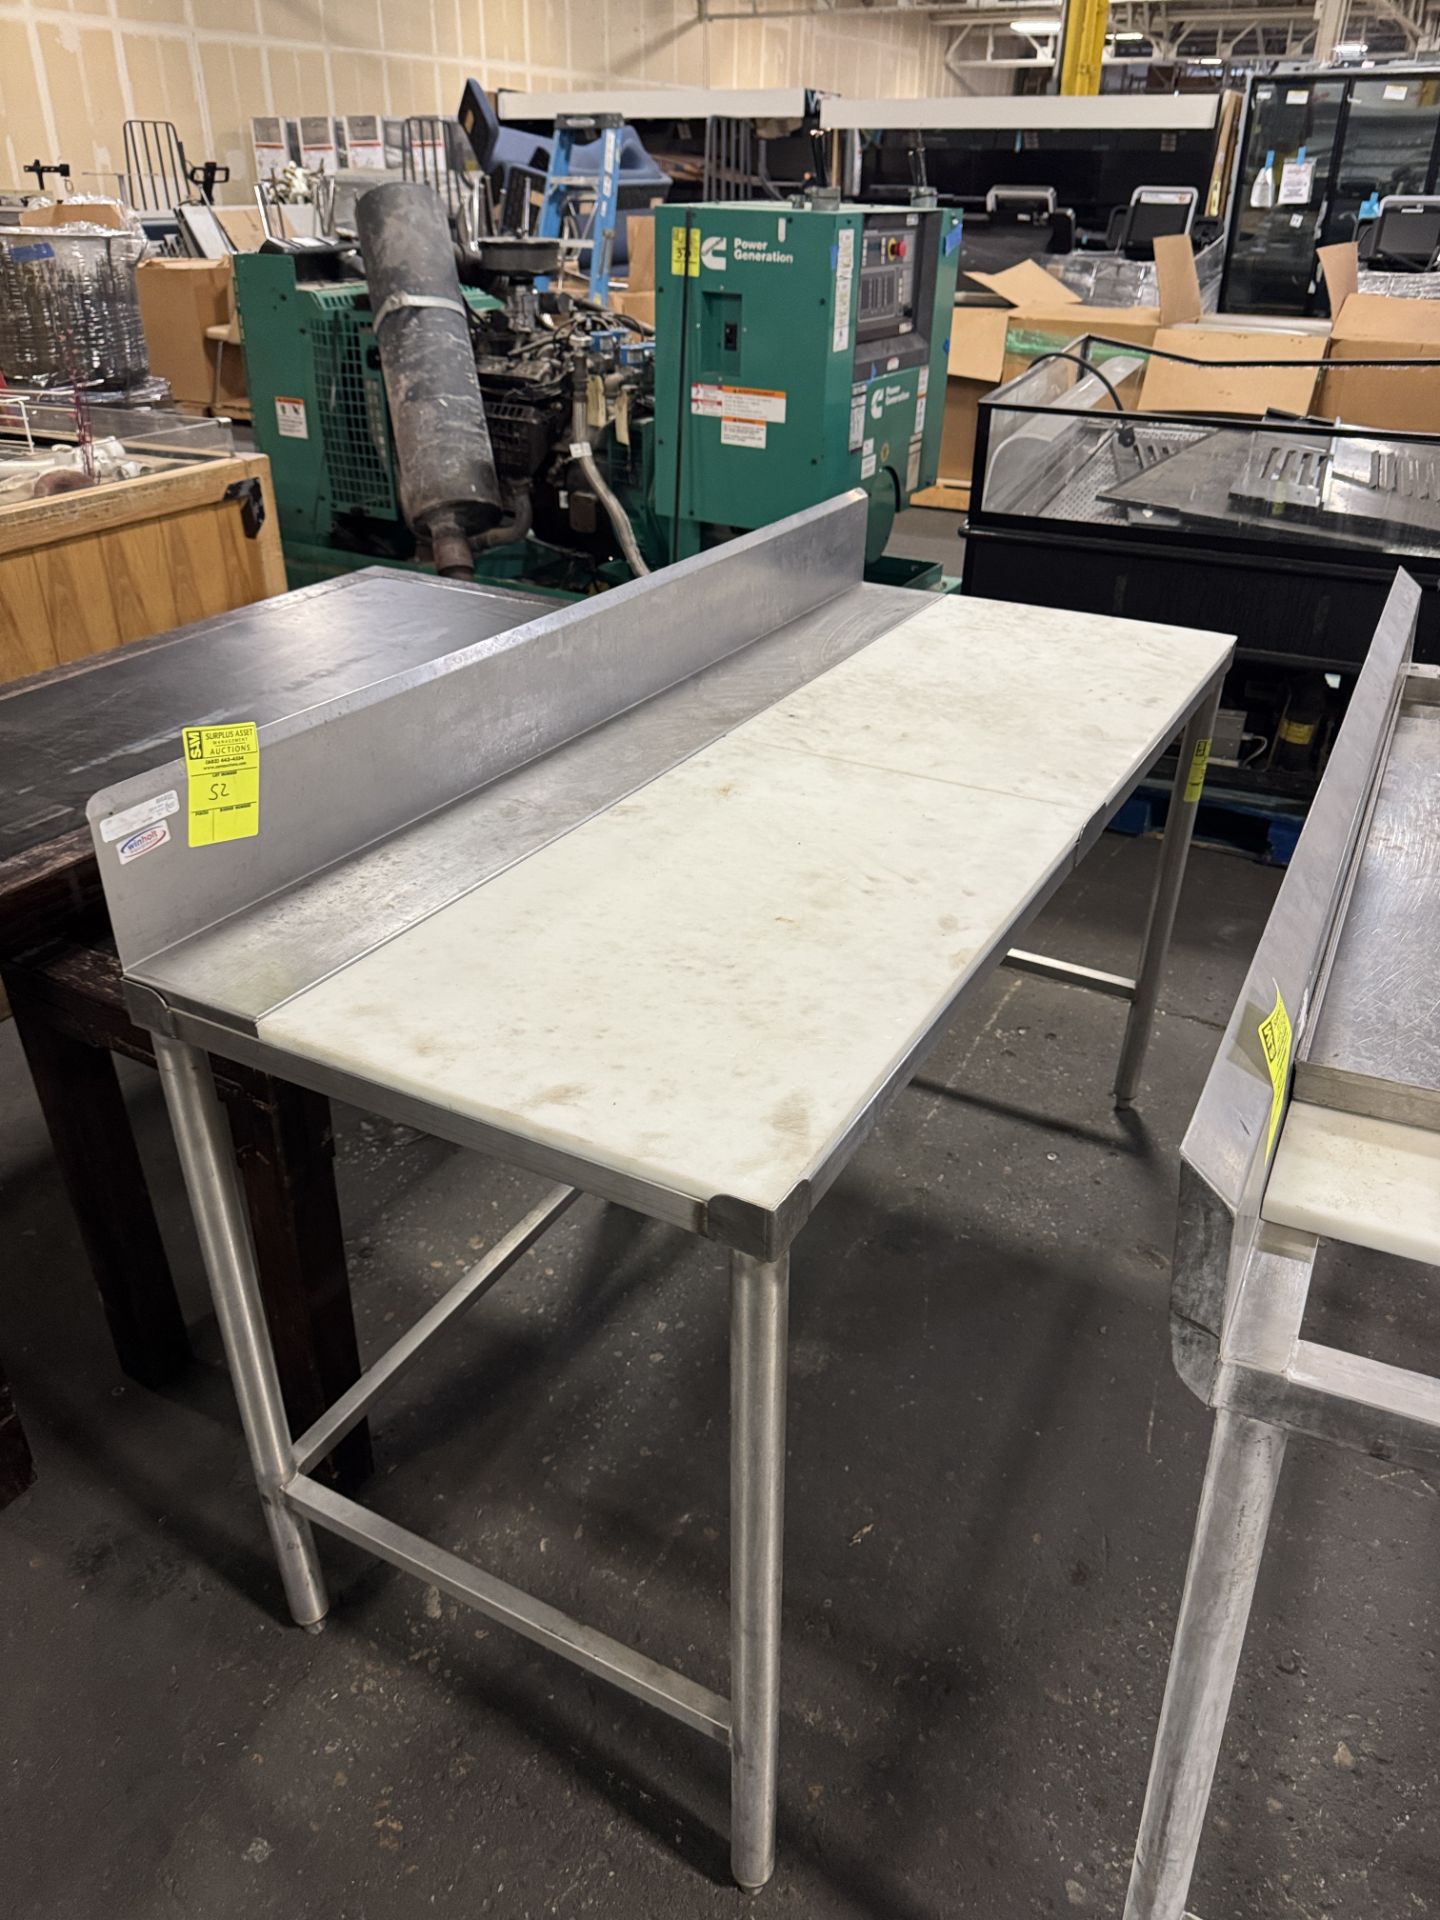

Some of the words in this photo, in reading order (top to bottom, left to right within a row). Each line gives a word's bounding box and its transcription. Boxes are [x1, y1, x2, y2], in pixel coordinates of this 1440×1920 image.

[734, 237, 768, 251] Power
[733, 249, 794, 264] Generation
[205, 731, 234, 741] SURPLUS
[235, 728, 253, 737] ASSET
[209, 744, 251, 755] AUCTIONS
[127, 829, 158, 850] winholt
